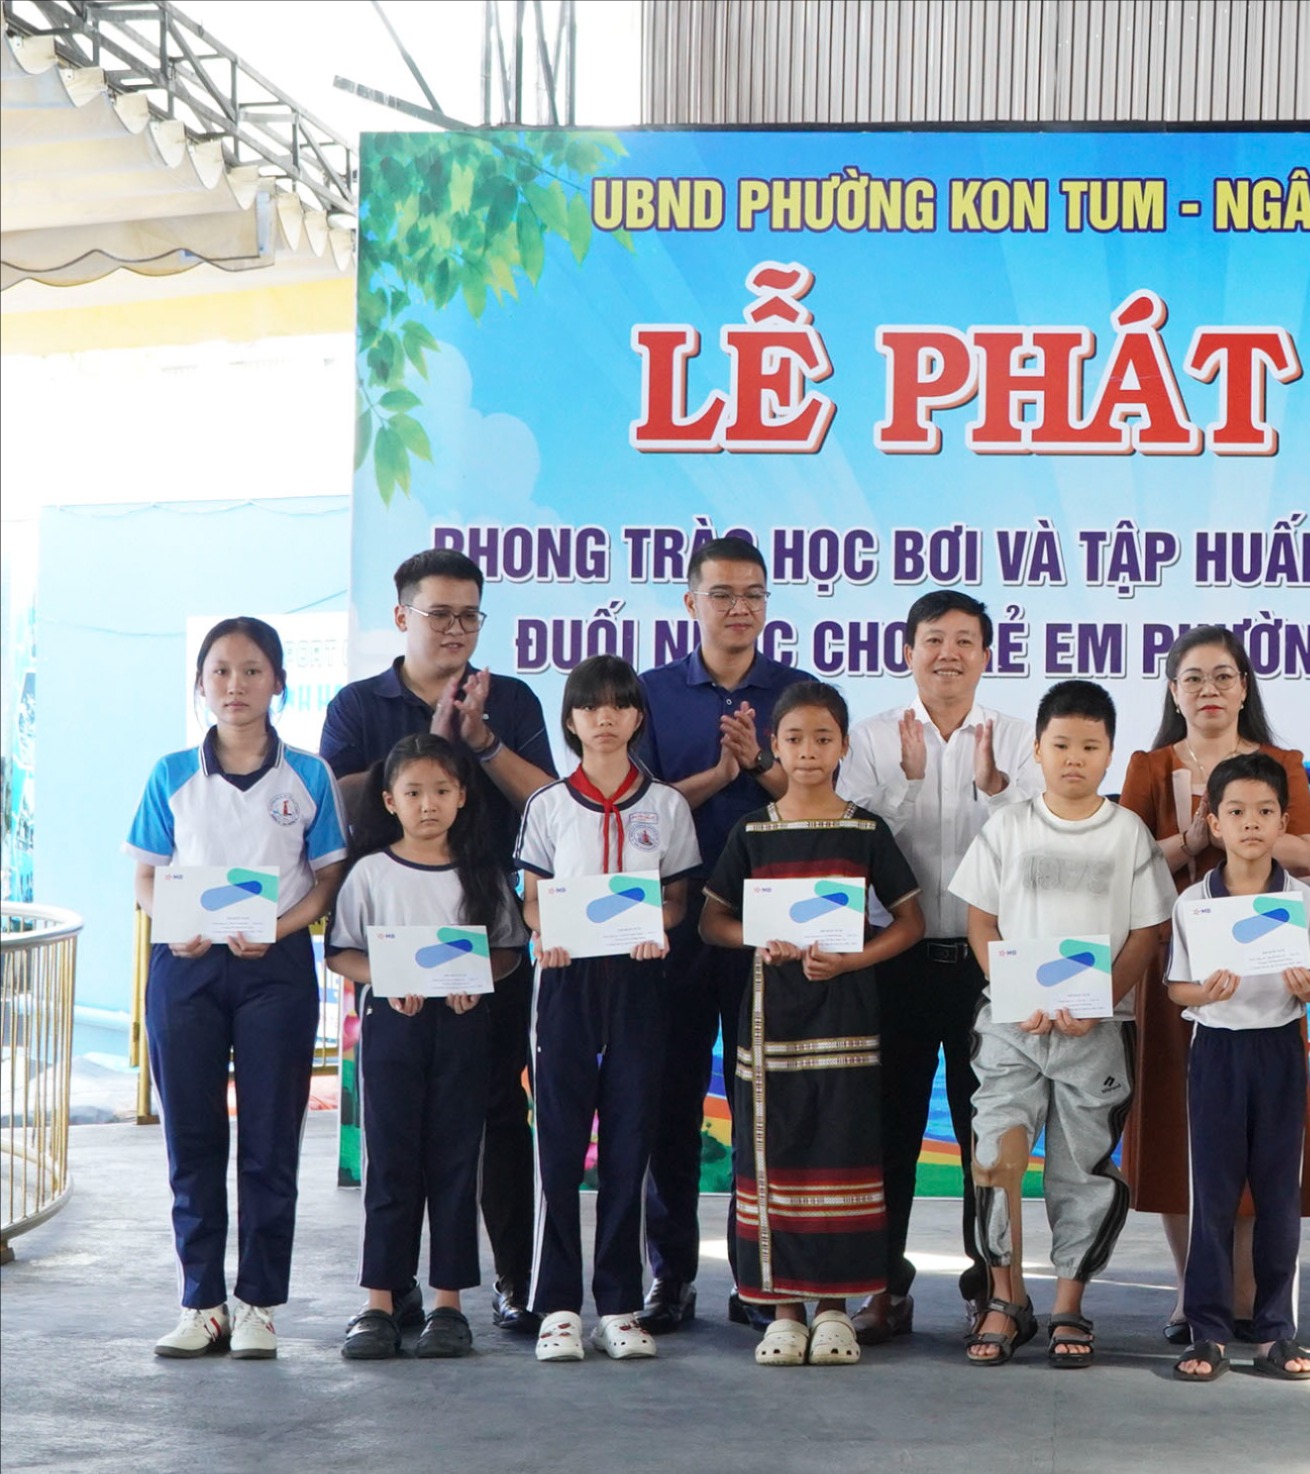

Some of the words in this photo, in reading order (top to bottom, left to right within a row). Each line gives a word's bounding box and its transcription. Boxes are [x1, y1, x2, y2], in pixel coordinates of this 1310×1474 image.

[592, 177, 724, 233] UBND
[738, 167, 937, 233] PHƯỜNG
[949, 177, 1049, 233] KON
[1061, 178, 1168, 233] TUM
[632, 262, 834, 451] LỄ
[876, 290, 1299, 453] PHÁT
[773, 527, 876, 593] HỌC
[892, 524, 978, 583] BƠI
[996, 519, 1063, 584] VÀ
[1079, 519, 1178, 595] TẬP
[515, 600, 635, 670] ĐUỐI
[1044, 622, 1124, 675] EM
